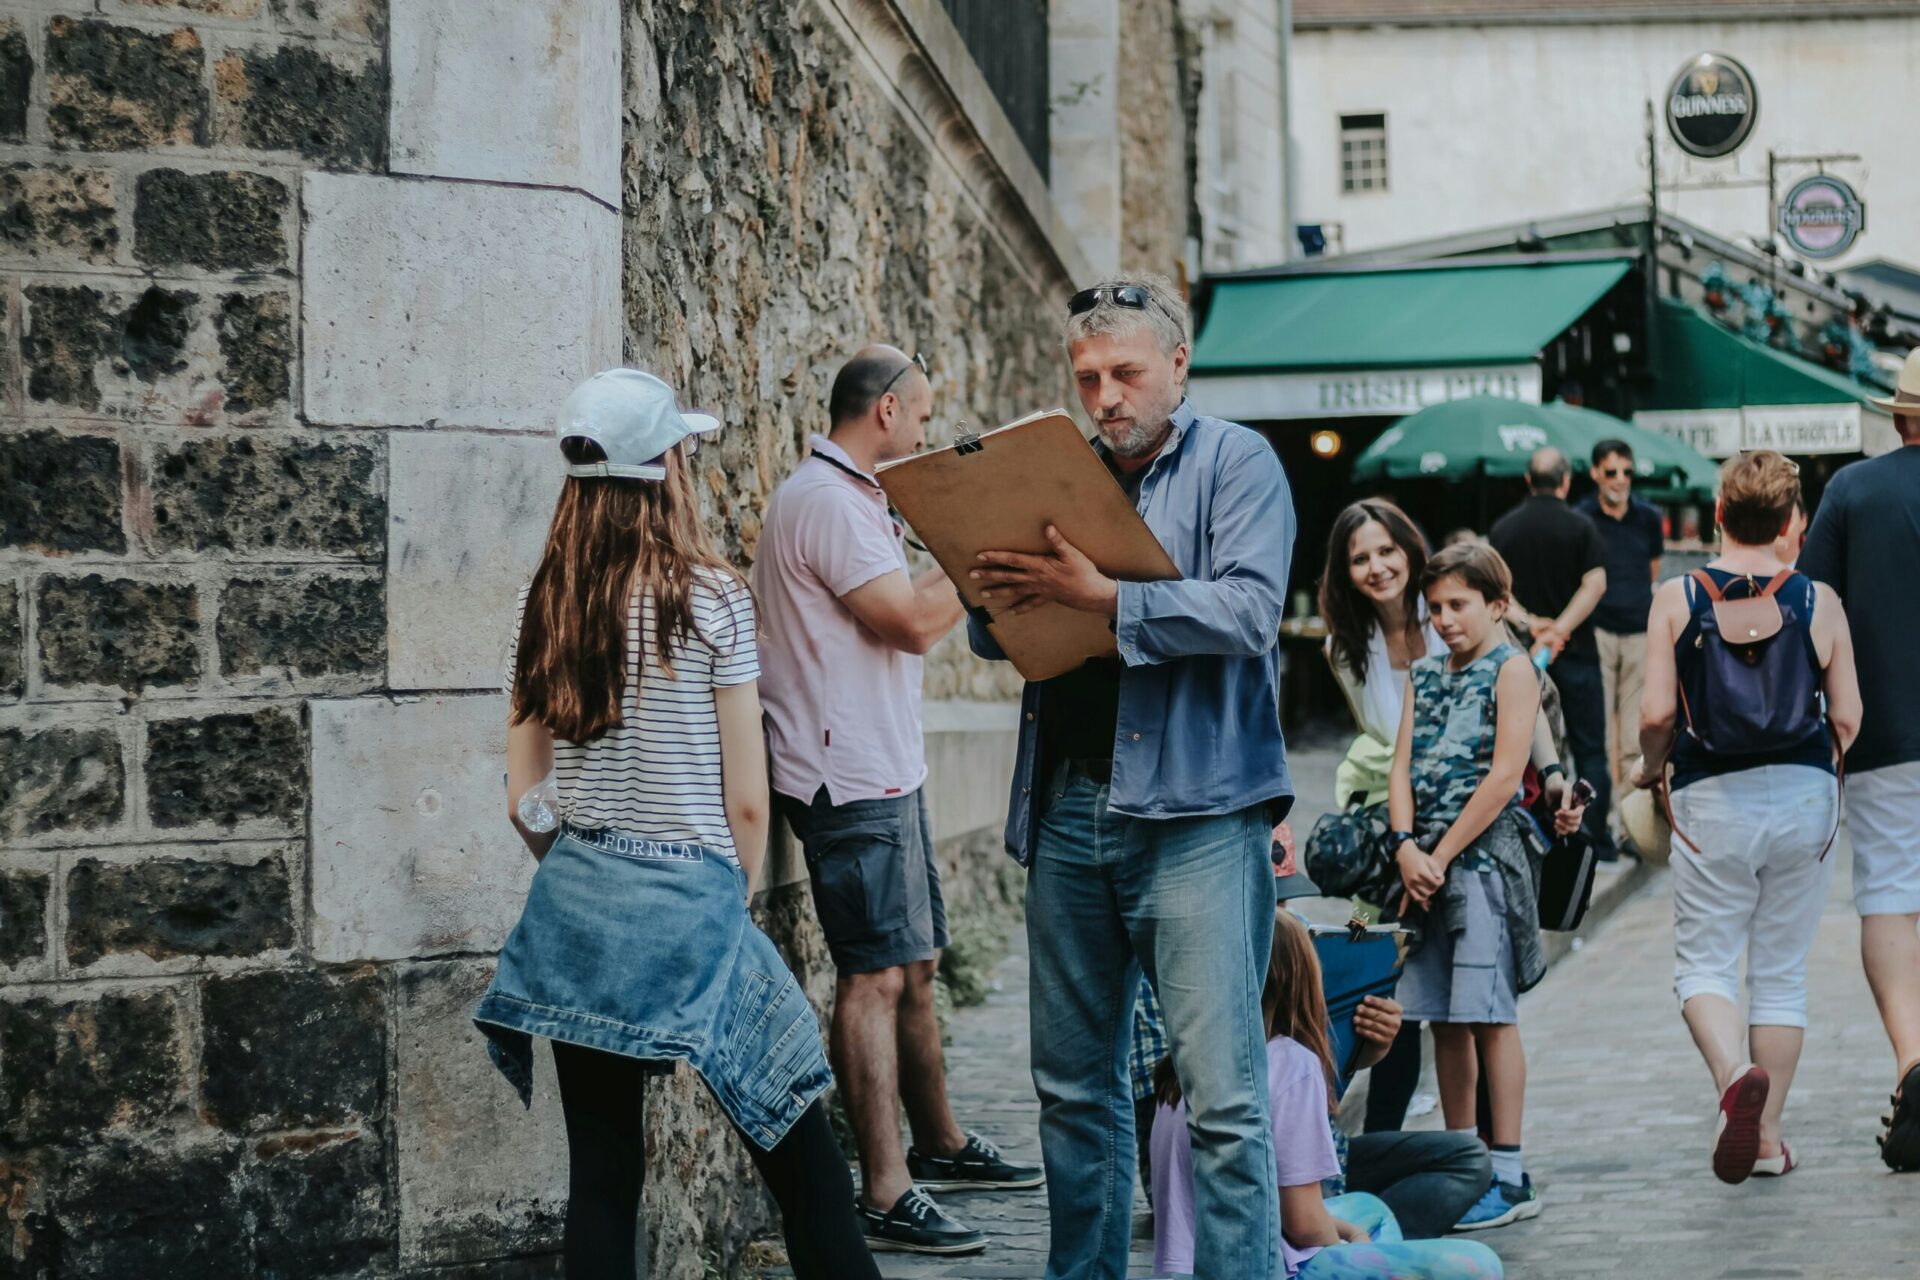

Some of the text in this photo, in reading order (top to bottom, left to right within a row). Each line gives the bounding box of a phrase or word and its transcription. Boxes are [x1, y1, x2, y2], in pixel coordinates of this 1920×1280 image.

[1672, 94, 1748, 118] GUINNESS
[1318, 372, 1520, 408] IRISH PUB
[567, 824, 696, 859] CALIFORNIA
